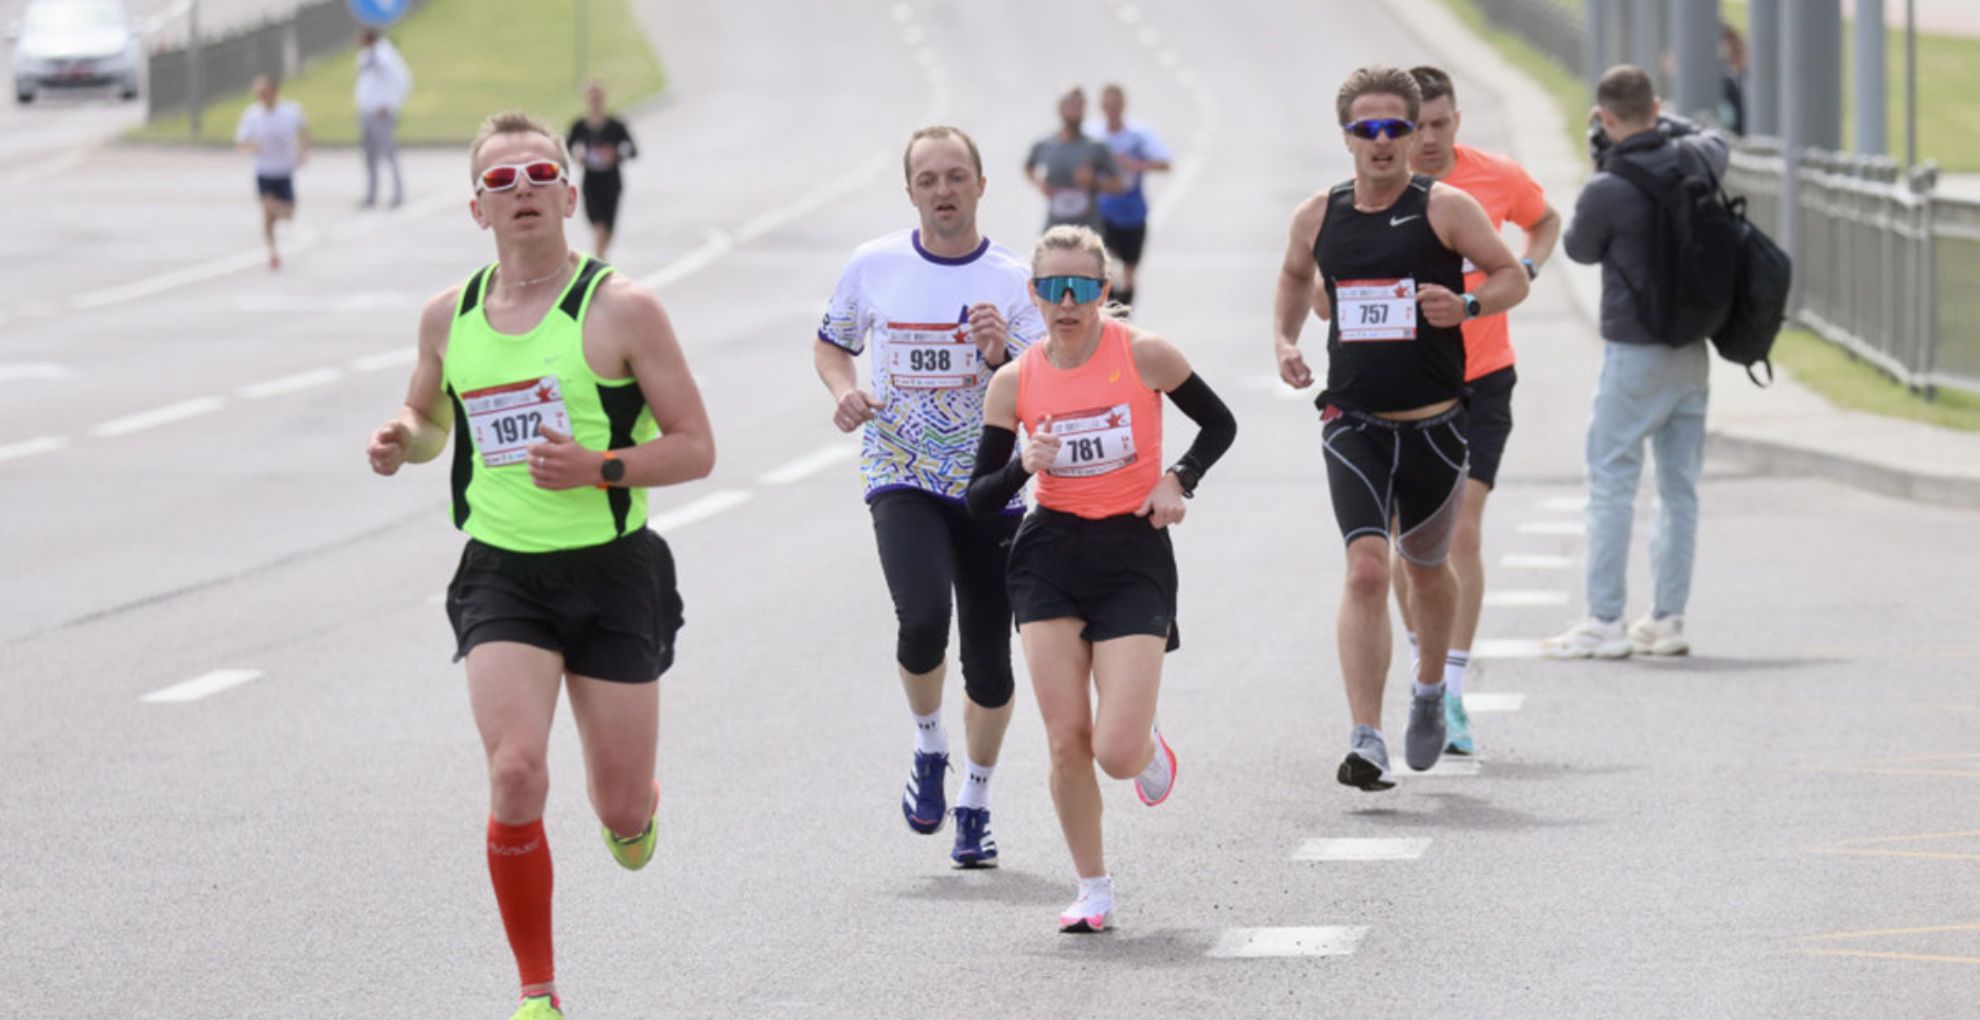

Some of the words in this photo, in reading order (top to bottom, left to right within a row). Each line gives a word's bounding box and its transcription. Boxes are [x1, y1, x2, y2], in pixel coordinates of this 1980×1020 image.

[1359, 304, 1389, 324] 757
[910, 349, 951, 371] 938
[491, 411, 543, 444] 1972
[1067, 437, 1104, 463] 781
